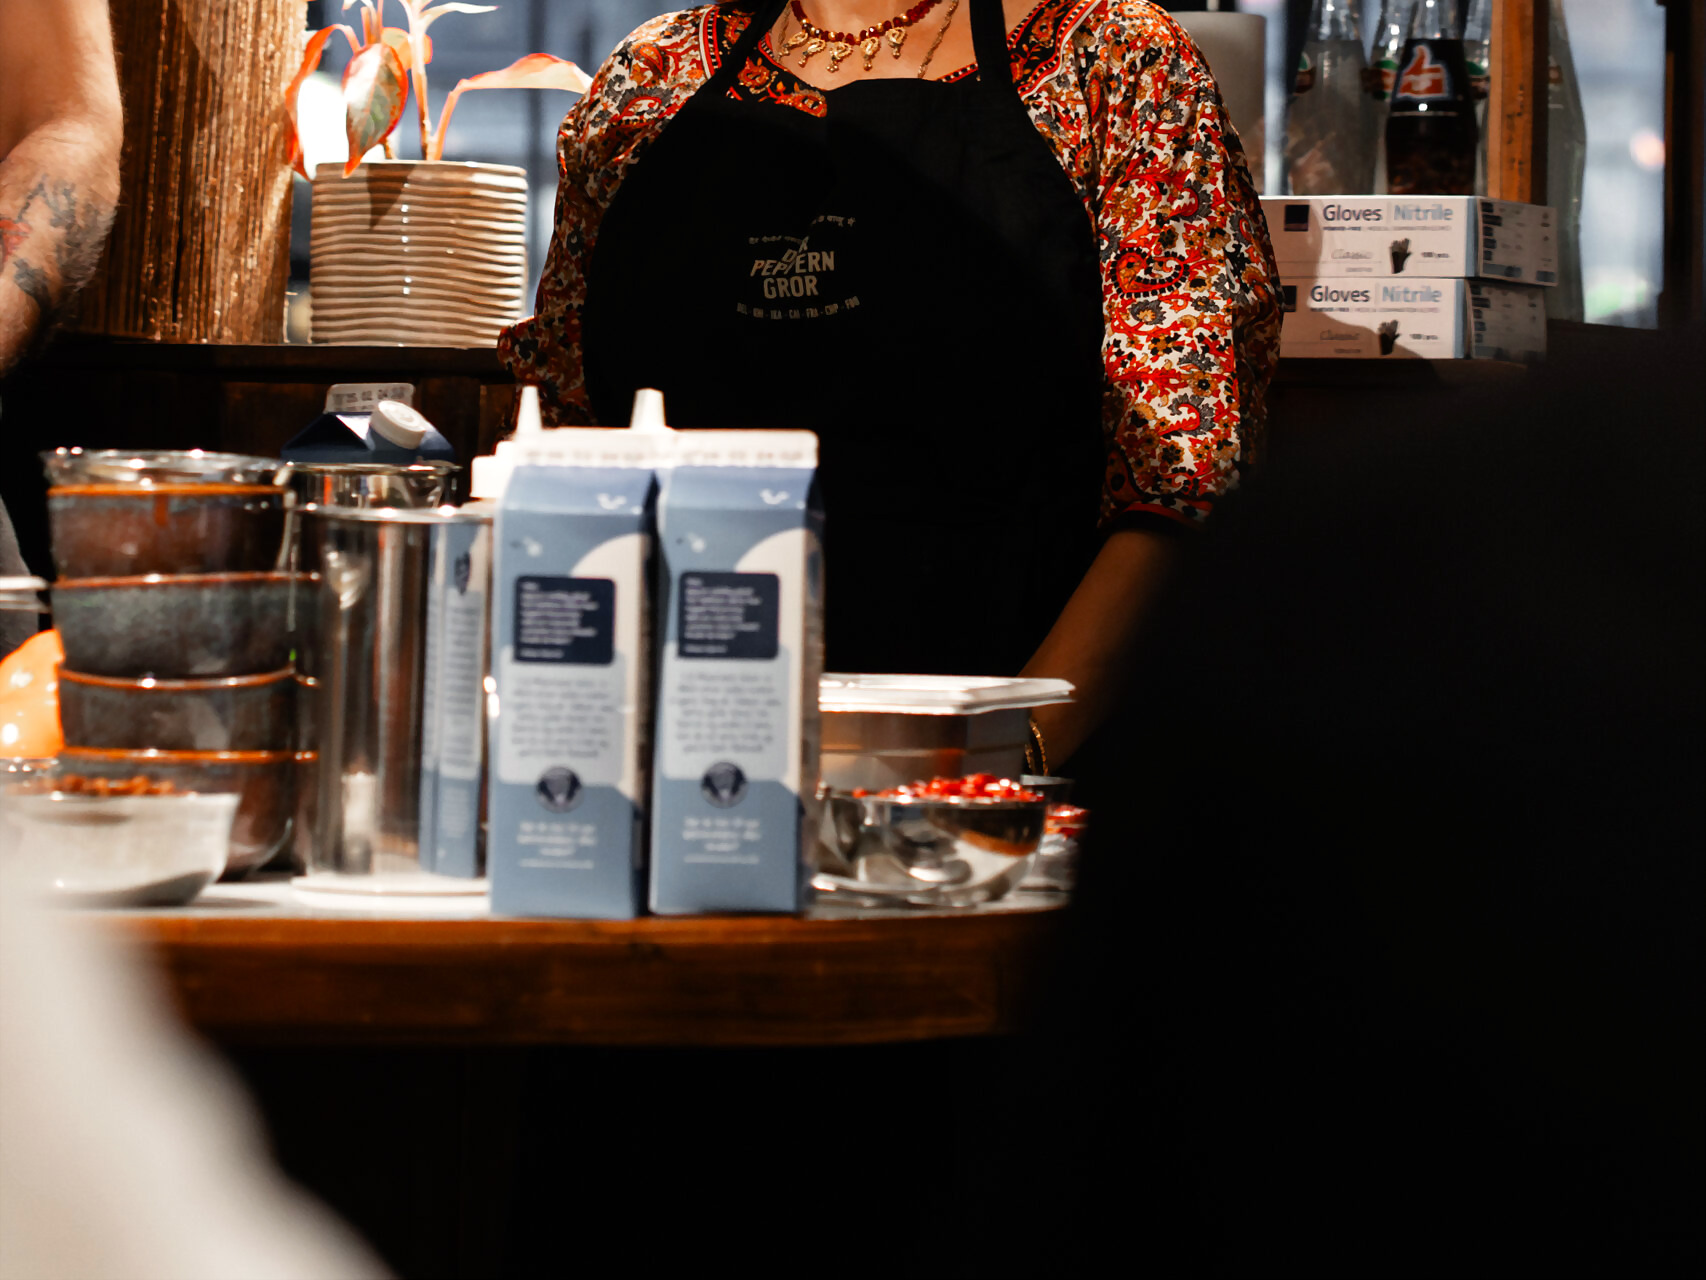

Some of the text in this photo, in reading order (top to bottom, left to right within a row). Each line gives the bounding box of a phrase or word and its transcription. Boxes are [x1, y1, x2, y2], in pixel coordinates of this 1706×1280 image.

[1322, 204, 1454, 221] Gloves Nitrile
[763, 275, 819, 299] GROR
[1309, 285, 1443, 302] Gloves Nitrile
